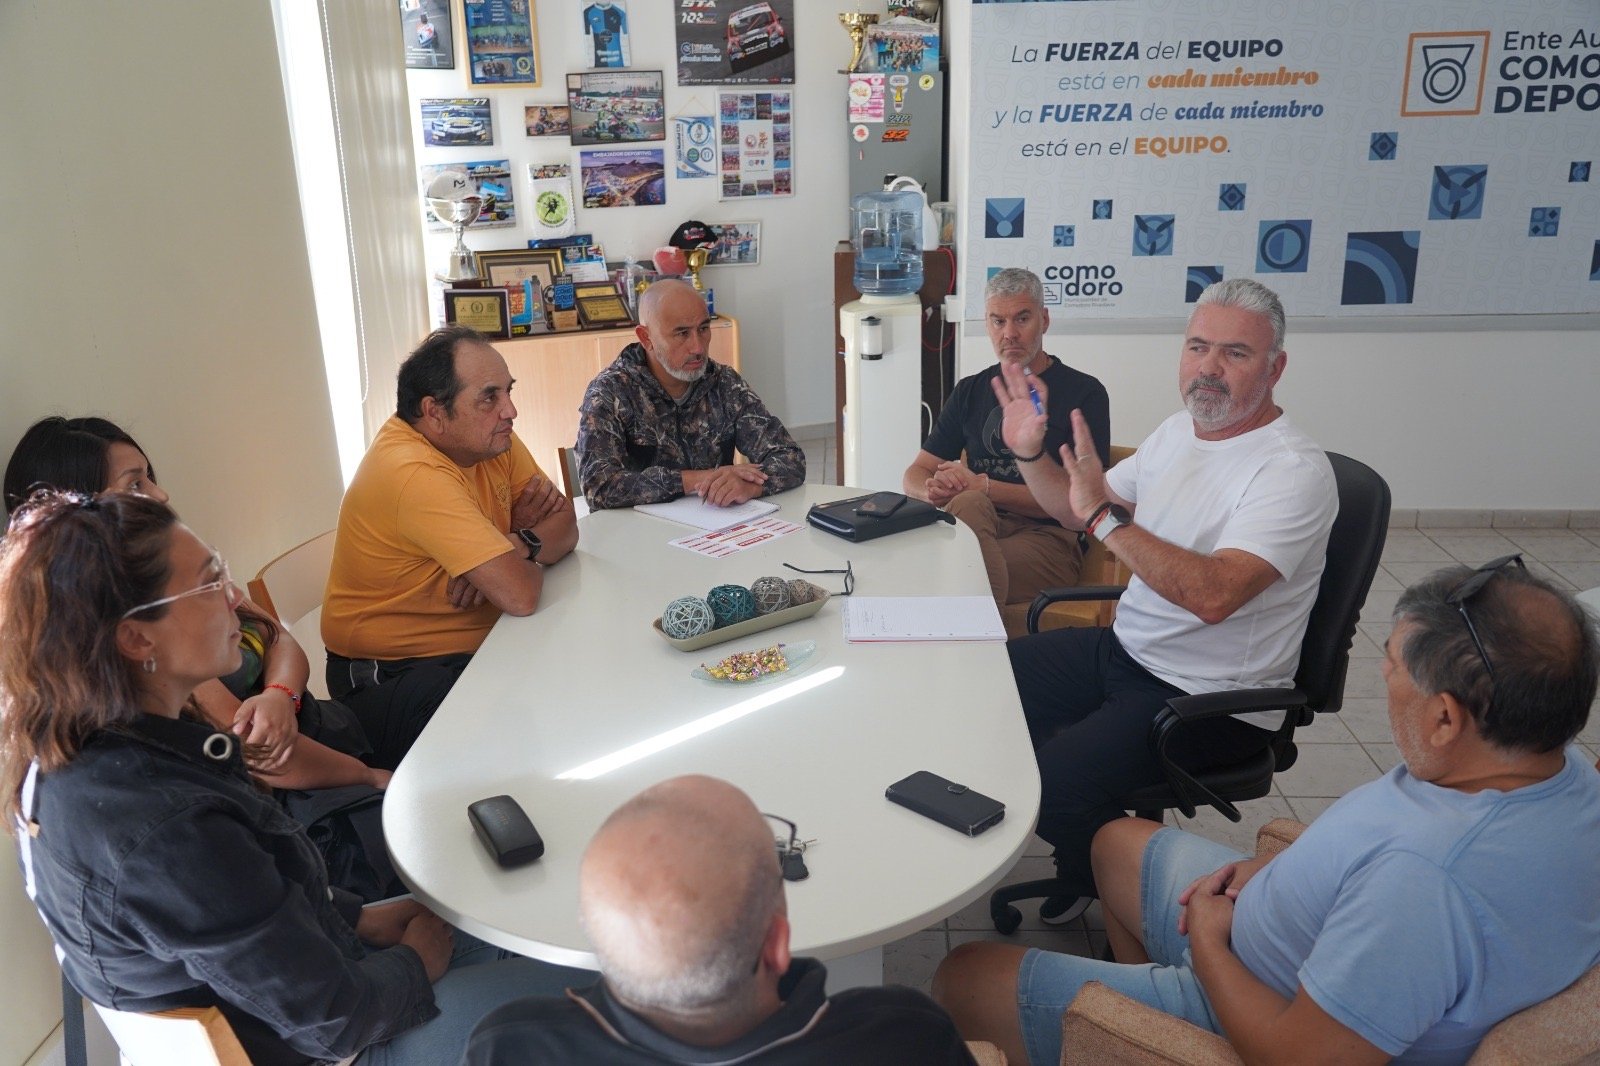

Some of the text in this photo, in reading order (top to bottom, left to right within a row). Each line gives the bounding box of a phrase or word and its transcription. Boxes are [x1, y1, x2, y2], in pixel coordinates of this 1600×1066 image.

[1011, 38, 1283, 63] La FUERZA del EQUIPO
[1503, 28, 1600, 51] Ente Au
[1058, 66, 1320, 90] está en cada miembro
[1499, 53, 1600, 81] COMO
[1493, 82, 1600, 114] DEPO
[991, 100, 1324, 129] y la FUERZA de cada miembro
[1021, 135, 1230, 158] está en el EQUIPO.
[1044, 265, 1116, 280] como
[1065, 277, 1123, 297] doro
